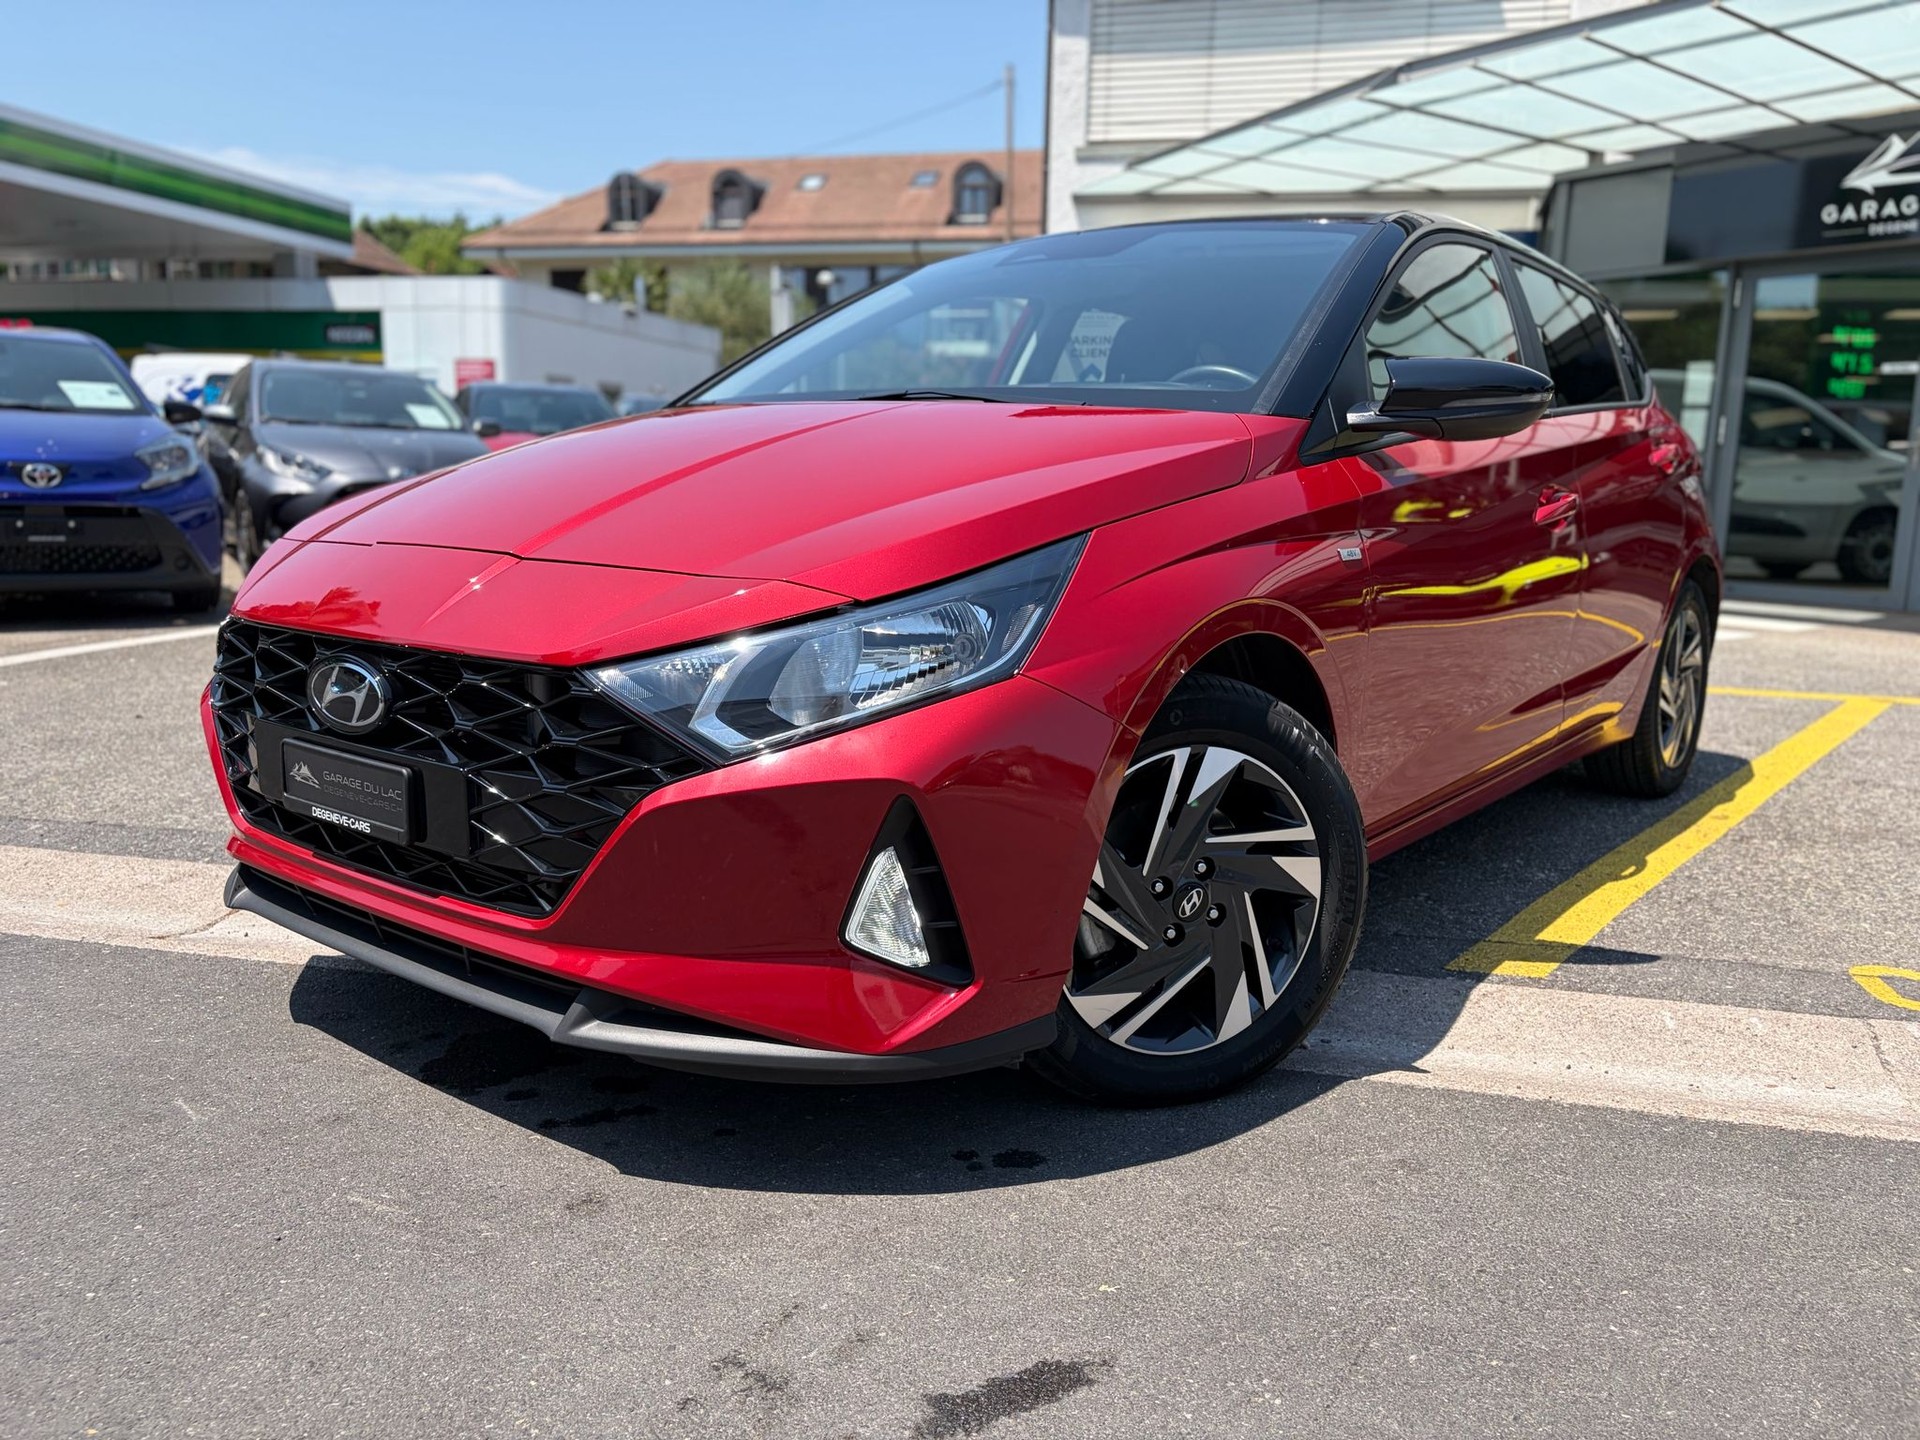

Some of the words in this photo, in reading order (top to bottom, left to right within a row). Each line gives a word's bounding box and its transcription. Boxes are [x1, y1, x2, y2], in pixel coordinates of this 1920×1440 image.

[1071, 347, 1110, 358] CLIEN
[323, 770, 362, 790] GARAGE
[364, 782, 379, 794] DU
[381, 787, 402, 801] LAC
[312, 806, 371, 833] DEGENEVE-CARS
